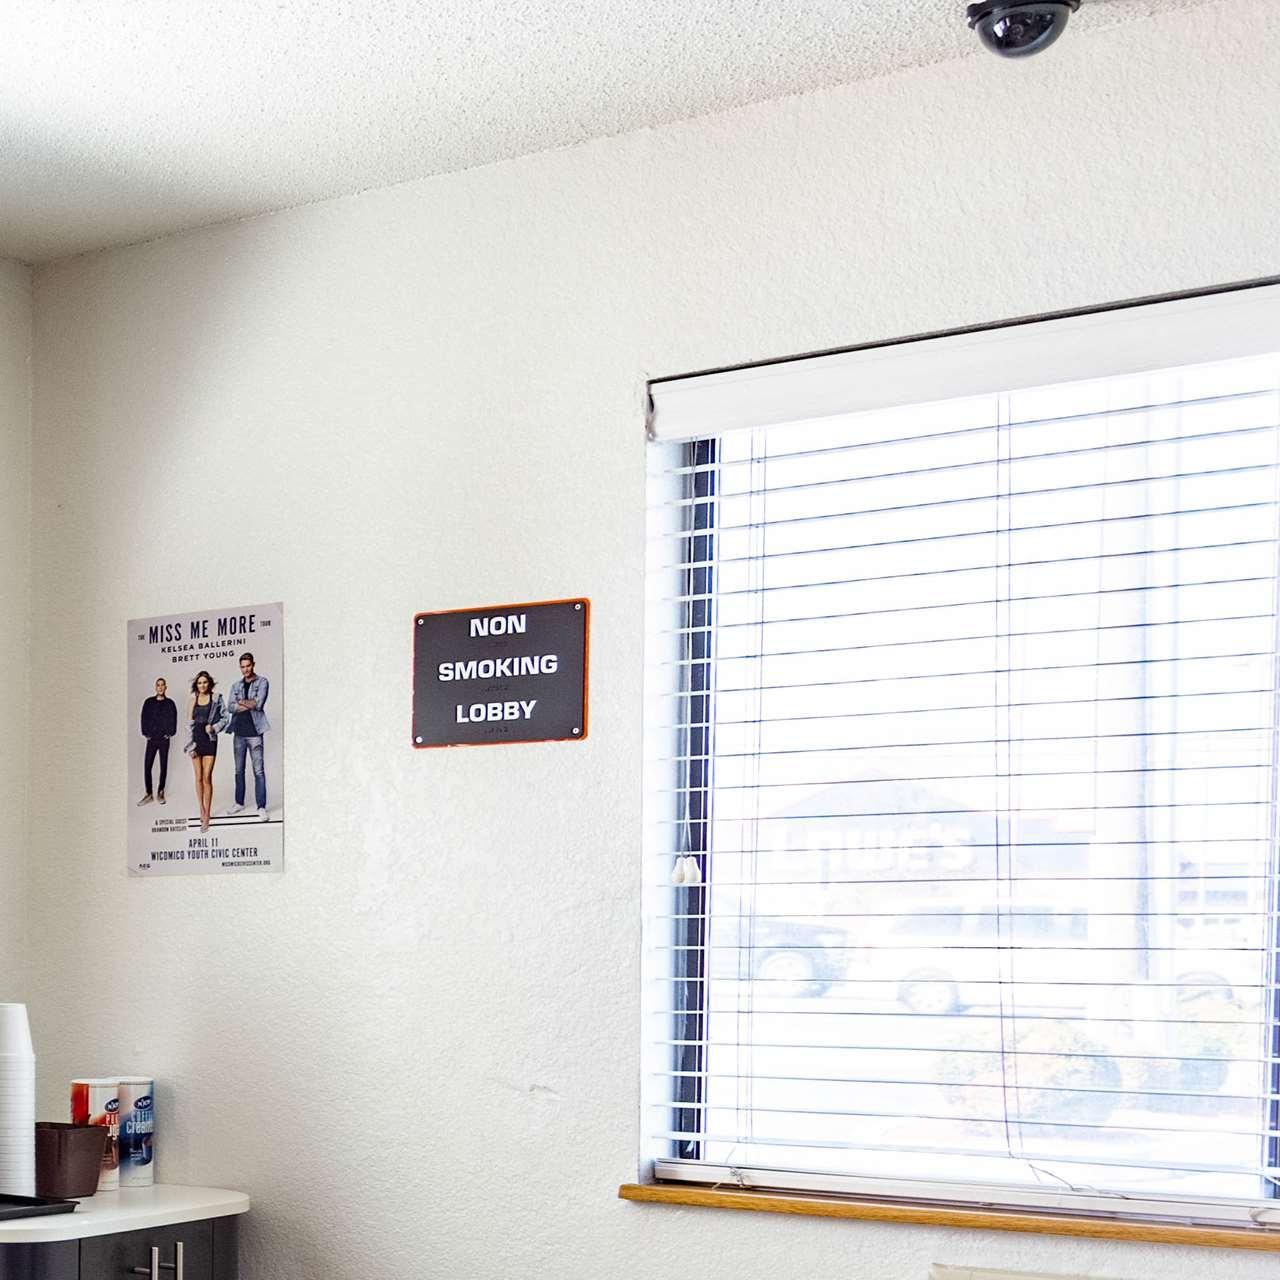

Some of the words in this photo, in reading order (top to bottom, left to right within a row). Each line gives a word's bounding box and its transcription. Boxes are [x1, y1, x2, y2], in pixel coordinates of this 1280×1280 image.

[149, 623, 182, 645] MISS
[190, 620, 209, 640] ME
[217, 614, 256, 637] MORE
[470, 614, 527, 637] NON
[160, 644, 195, 654] KELSEA
[198, 638, 247, 650] BALLERINI
[171, 653, 200, 663] BRETT
[204, 650, 235, 660] YOUNG
[438, 654, 558, 681] SMOKING
[456, 700, 537, 723] LOBBY
[188, 838, 208, 848] APRIL
[211, 838, 219, 848] 11
[151, 850, 185, 861] WICOMICO
[187, 849, 209, 860] YOUTH
[211, 848, 230, 859] CIVIC
[231, 847, 258, 858] CENTER
